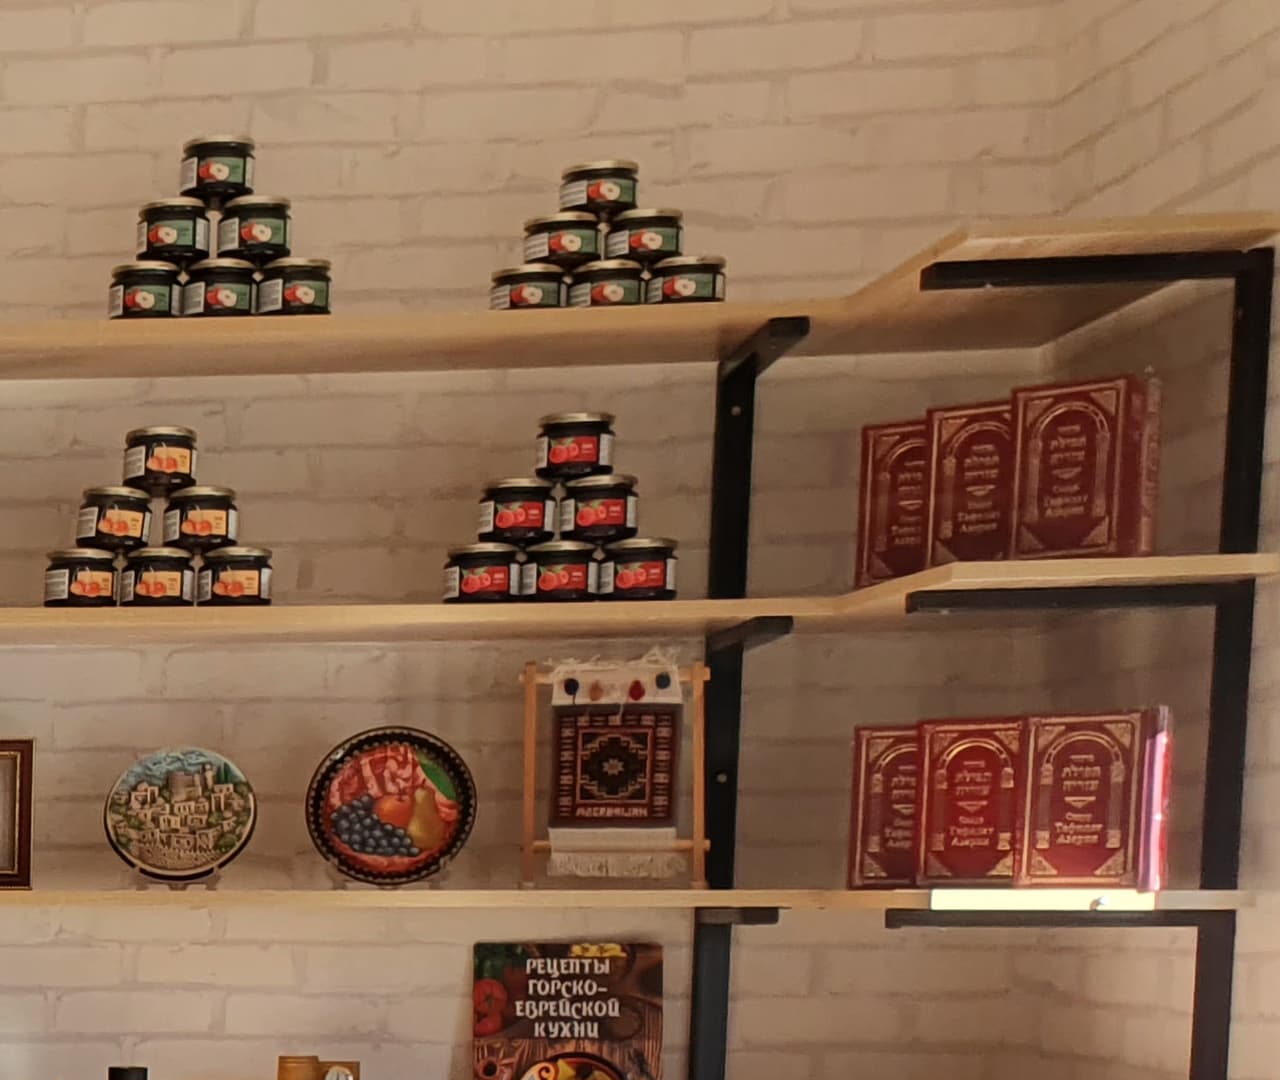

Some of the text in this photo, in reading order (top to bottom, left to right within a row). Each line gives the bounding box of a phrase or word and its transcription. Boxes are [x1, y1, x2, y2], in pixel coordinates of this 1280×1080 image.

[525, 957, 611, 978] РЕЦЕПТЫ
[528, 978, 608, 999] ГОРСКО-
[514, 998, 621, 1019] ЕВРЕЙСКОЙ
[534, 1021, 600, 1039] КУХНИ
